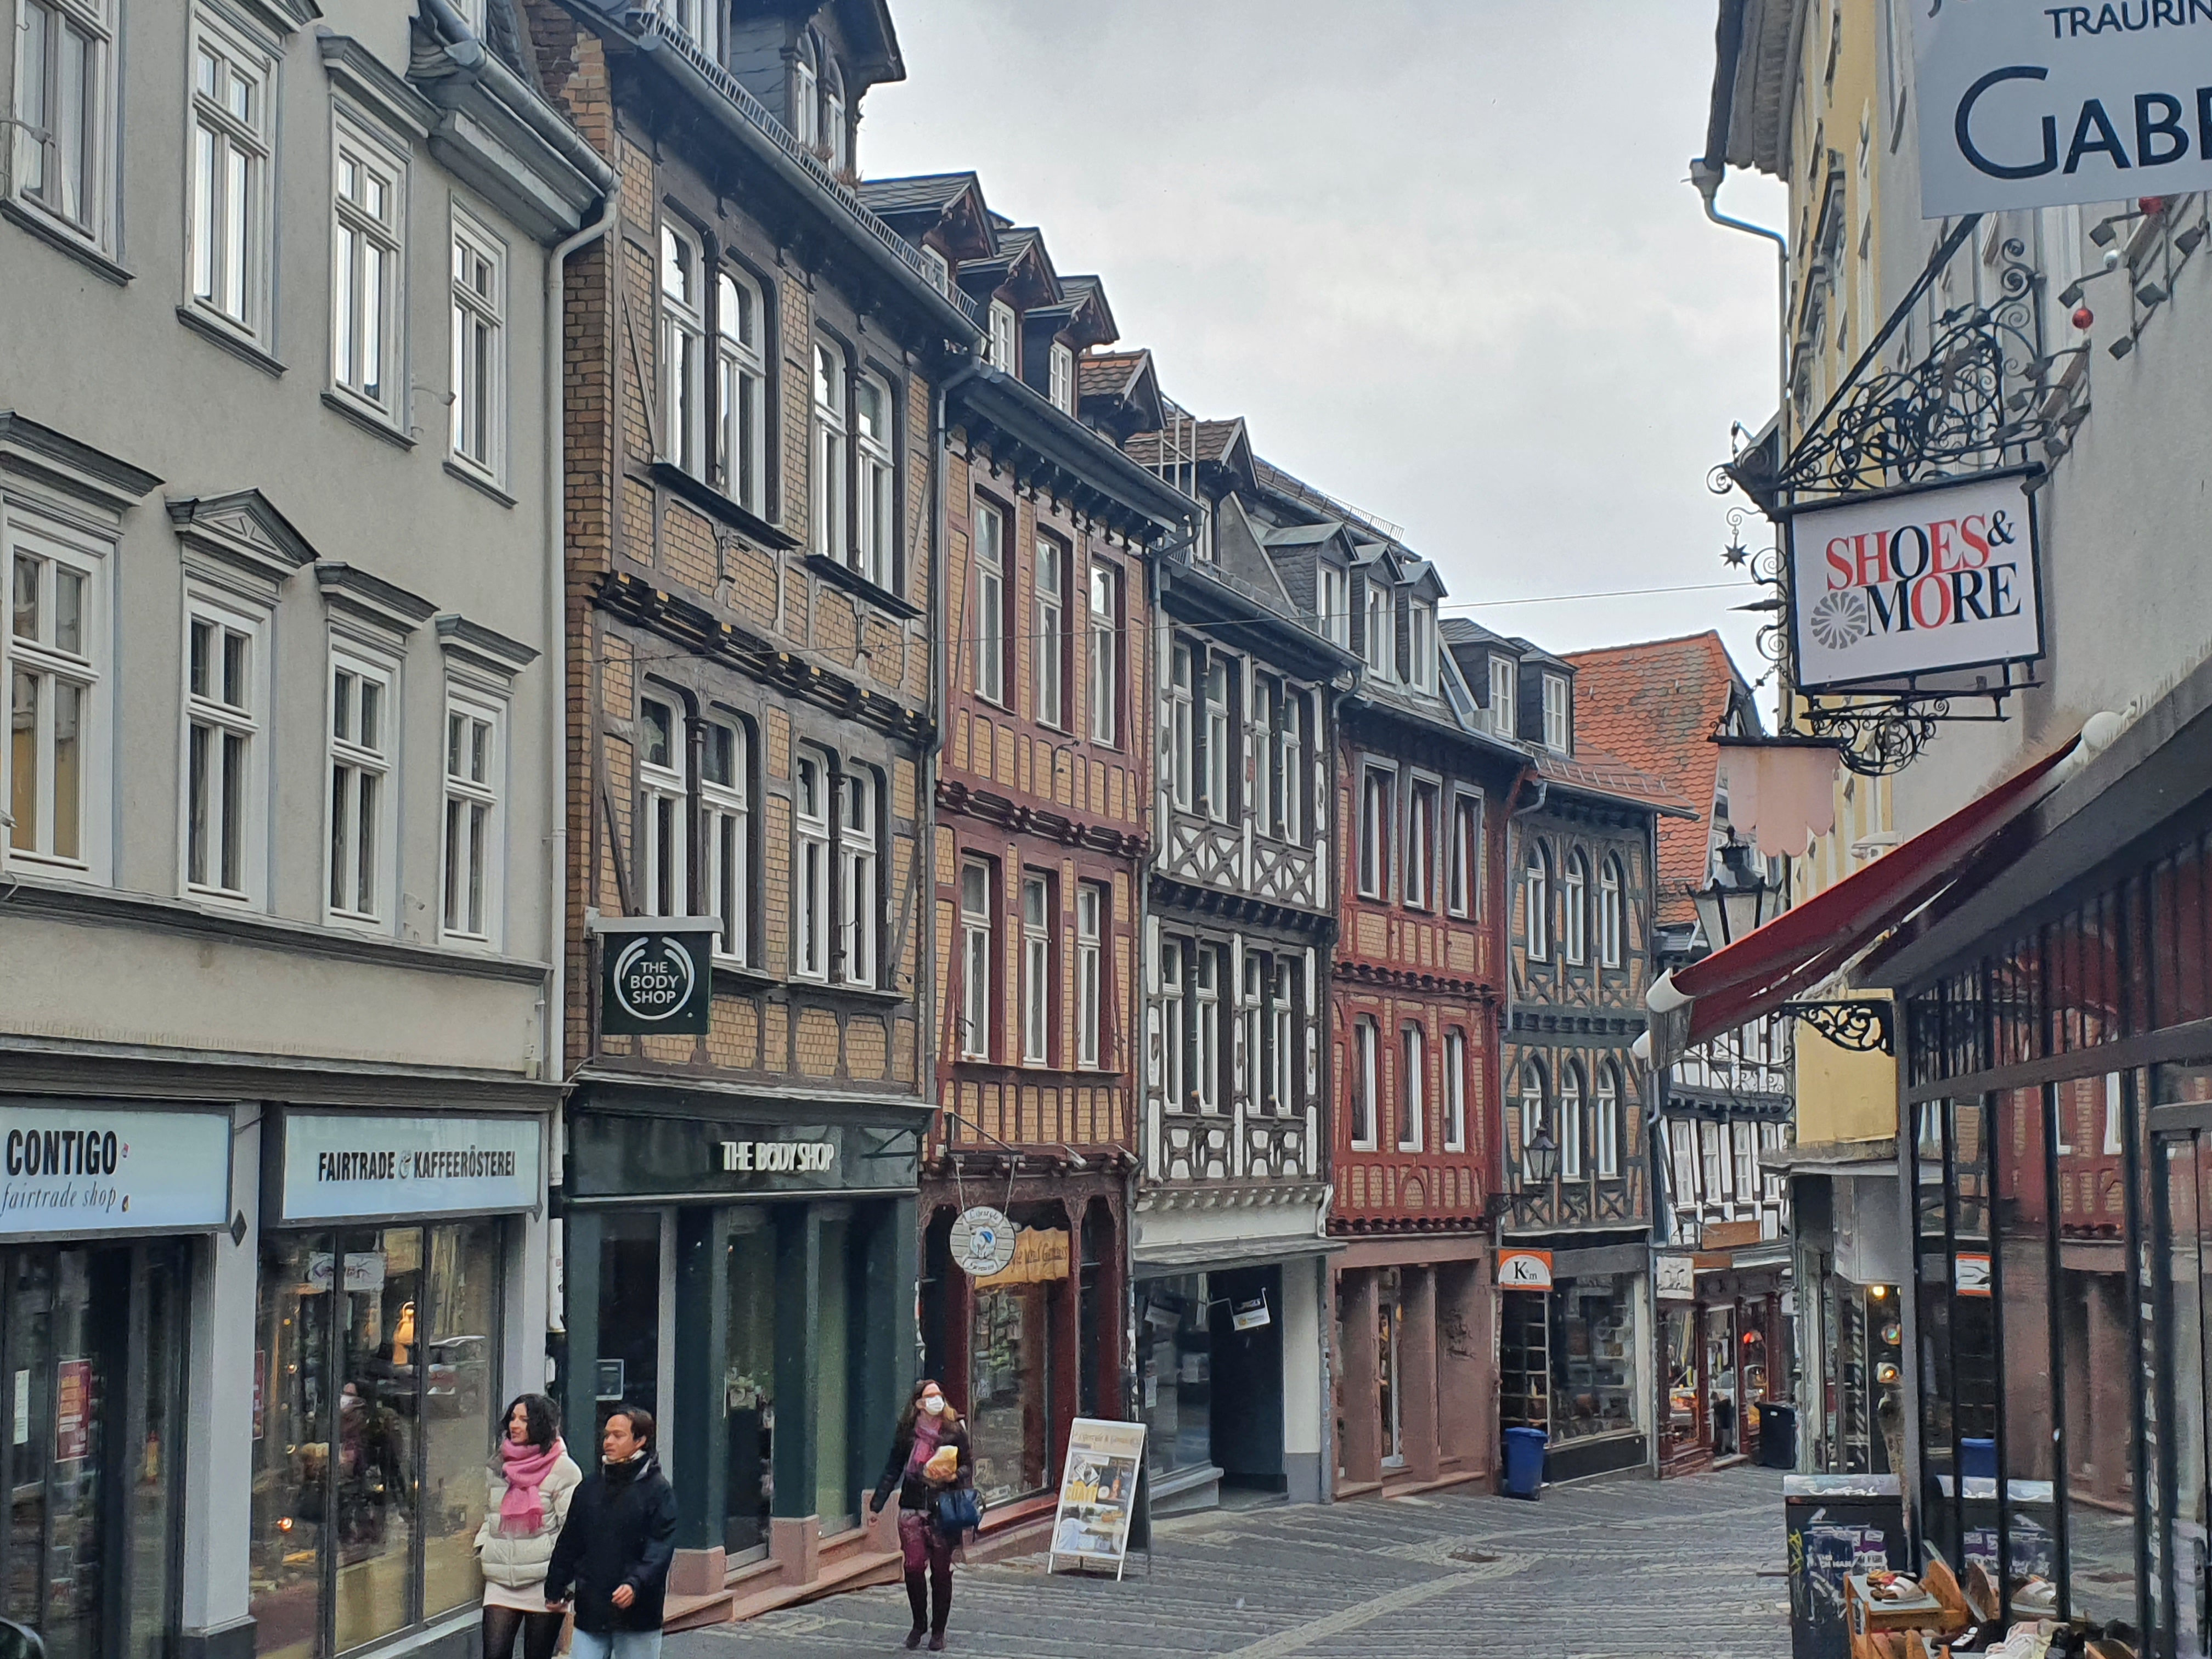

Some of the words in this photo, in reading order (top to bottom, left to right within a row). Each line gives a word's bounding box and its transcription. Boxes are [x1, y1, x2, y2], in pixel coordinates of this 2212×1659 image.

[1826, 514, 1991, 591] SHOES
[1863, 562, 2022, 637] MORE
[631, 975, 679, 989] BODY
[640, 962, 668, 973] THE
[632, 991, 676, 1003] SHOP
[7, 1129, 117, 1176] CONTIGO
[318, 1152, 396, 1182] FAIRTRADE
[414, 1144, 516, 1178] KAFFEERÖSTEREI
[720, 1142, 753, 1170] THE
[755, 1142, 797, 1171] BODY
[797, 1143, 834, 1171] SHOP
[0, 1181, 77, 1217] fairtrade
[82, 1180, 116, 1214] shop
